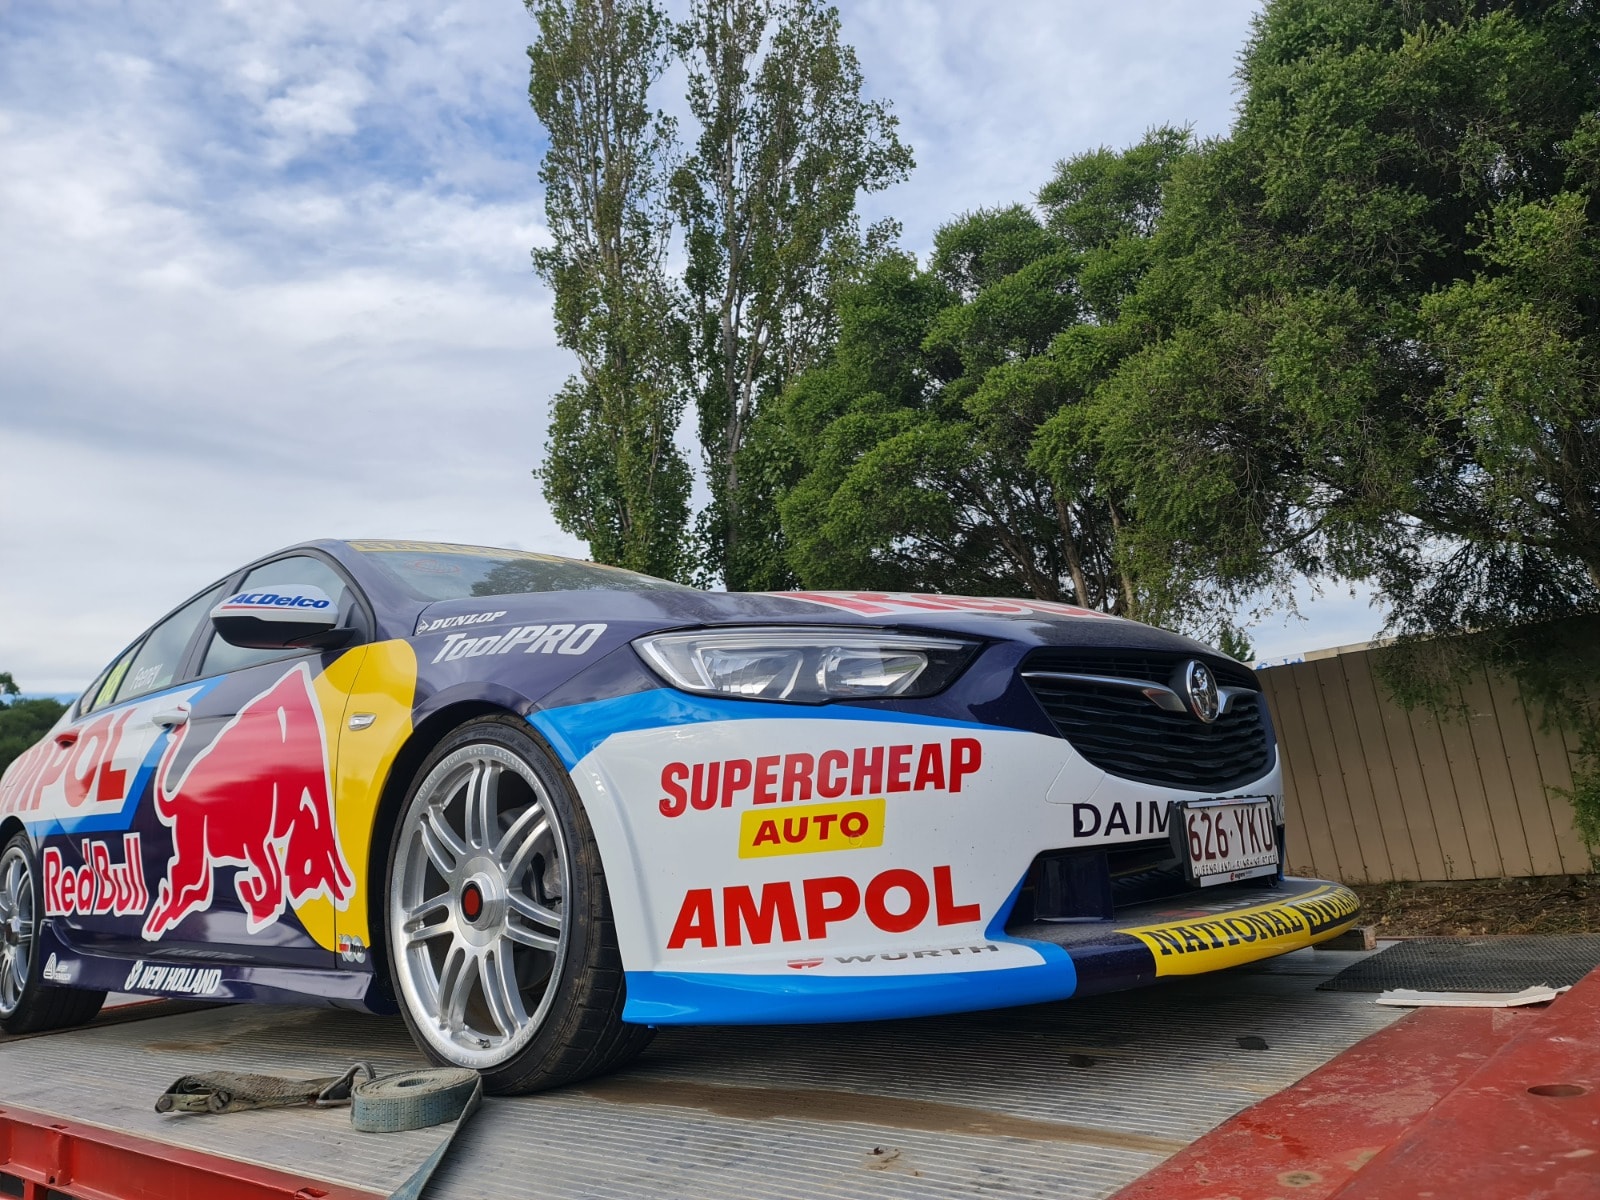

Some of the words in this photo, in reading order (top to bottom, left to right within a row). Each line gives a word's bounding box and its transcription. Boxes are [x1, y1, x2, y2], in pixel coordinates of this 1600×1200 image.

[228, 593, 330, 609] ACDelco
[428, 610, 508, 631] DUNLOP
[430, 623, 608, 665] ToolPRO
[658, 737, 982, 818] SUPERCHEAP
[752, 811, 869, 847] AUTO
[43, 839, 96, 915] Red
[92, 833, 149, 915] Bull
[666, 865, 982, 950] AMPOL
[1143, 905, 1305, 956] NATIONAL
[137, 965, 170, 990] NEW
[161, 967, 222, 995] HOLLAND
